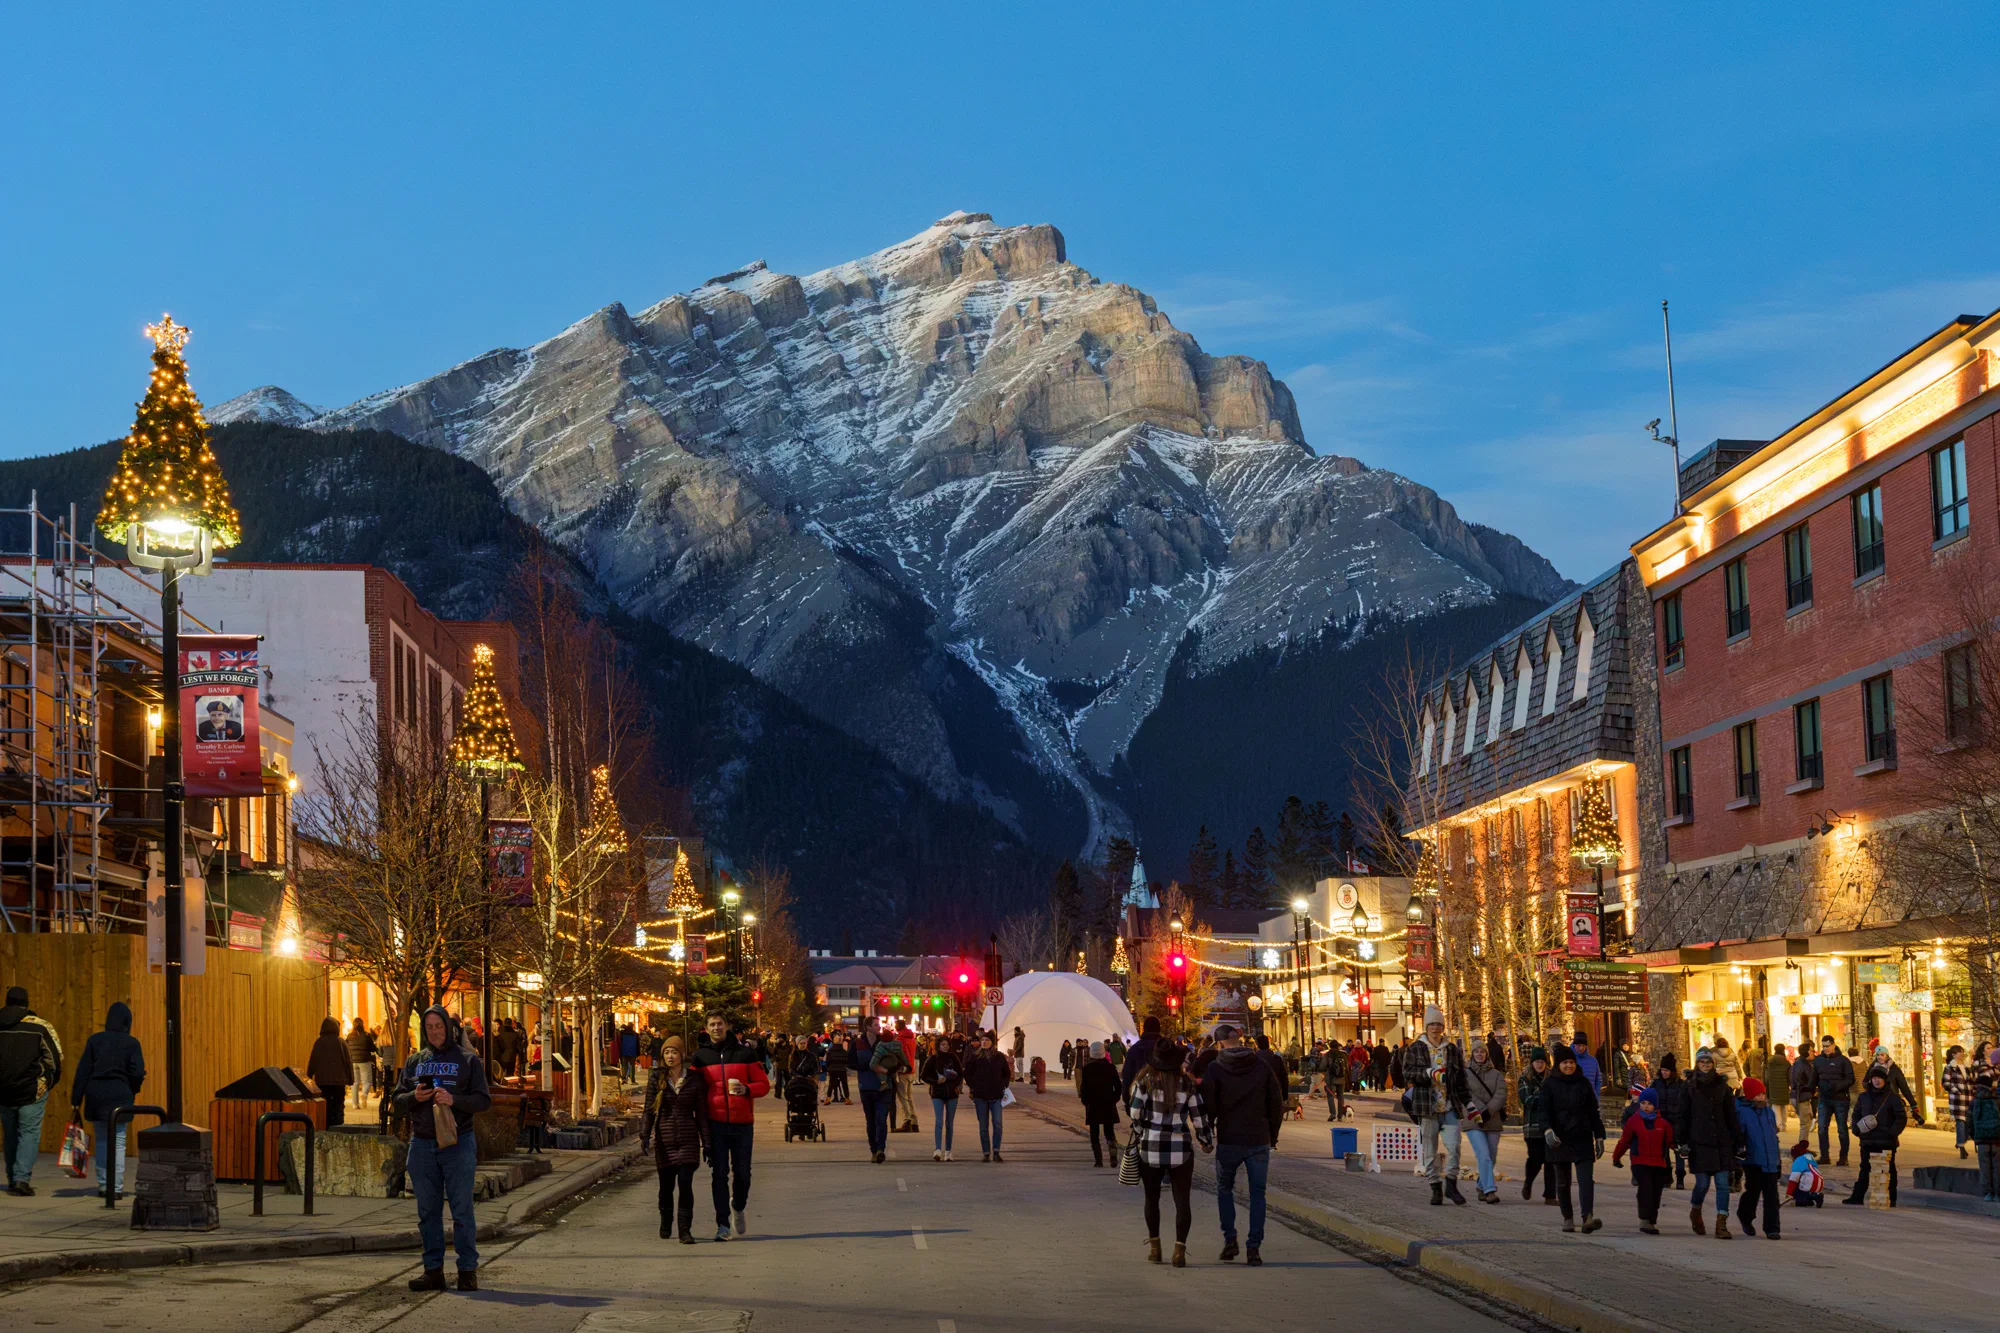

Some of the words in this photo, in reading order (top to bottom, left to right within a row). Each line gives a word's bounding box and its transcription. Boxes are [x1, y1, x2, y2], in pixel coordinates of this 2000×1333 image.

[182, 675, 204, 685] LEST
[205, 674, 219, 682] WE
[220, 674, 256, 684] FORGET
[1586, 963, 1607, 971] Parking
[1620, 1004, 1643, 1012] Highway
[416, 1062, 459, 1077] DUKE
